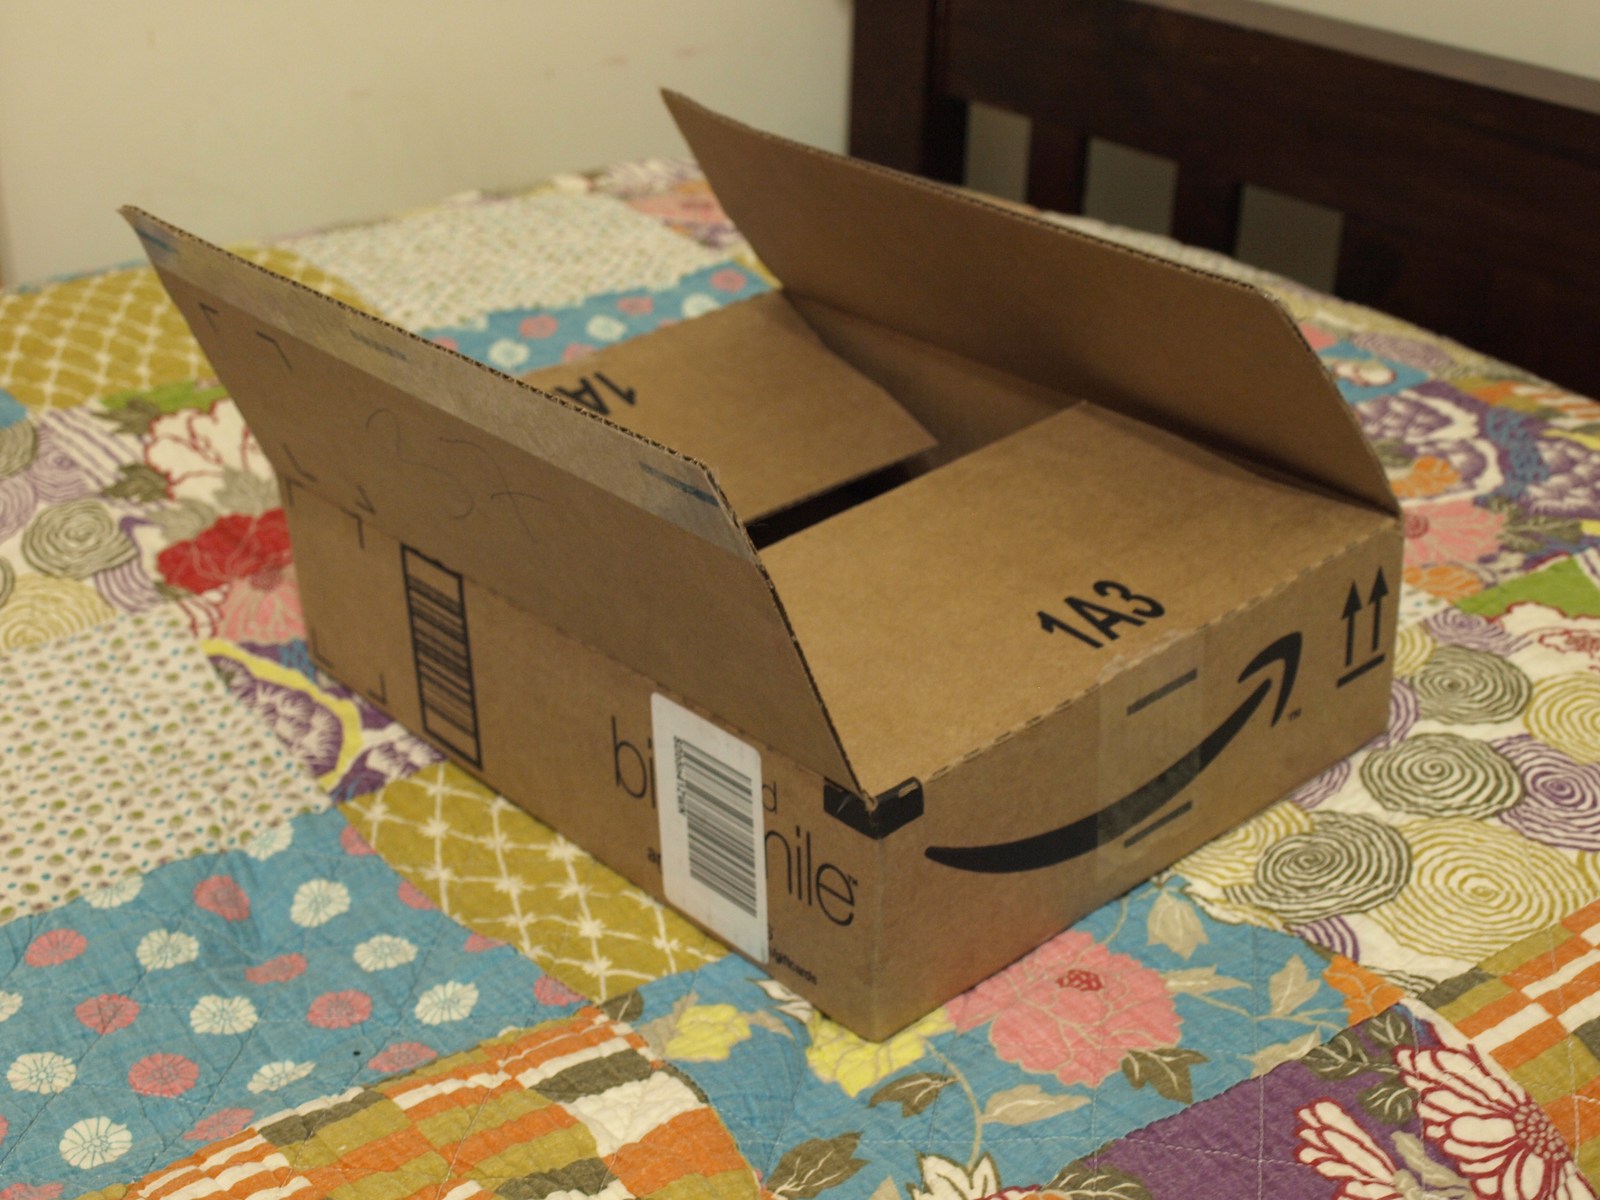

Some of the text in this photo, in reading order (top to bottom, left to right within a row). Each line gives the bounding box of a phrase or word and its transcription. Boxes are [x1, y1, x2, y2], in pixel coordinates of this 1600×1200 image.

[554, 371, 636, 416] 1A
[1036, 579, 1165, 649] 1A3
[611, 715, 656, 809] bi
